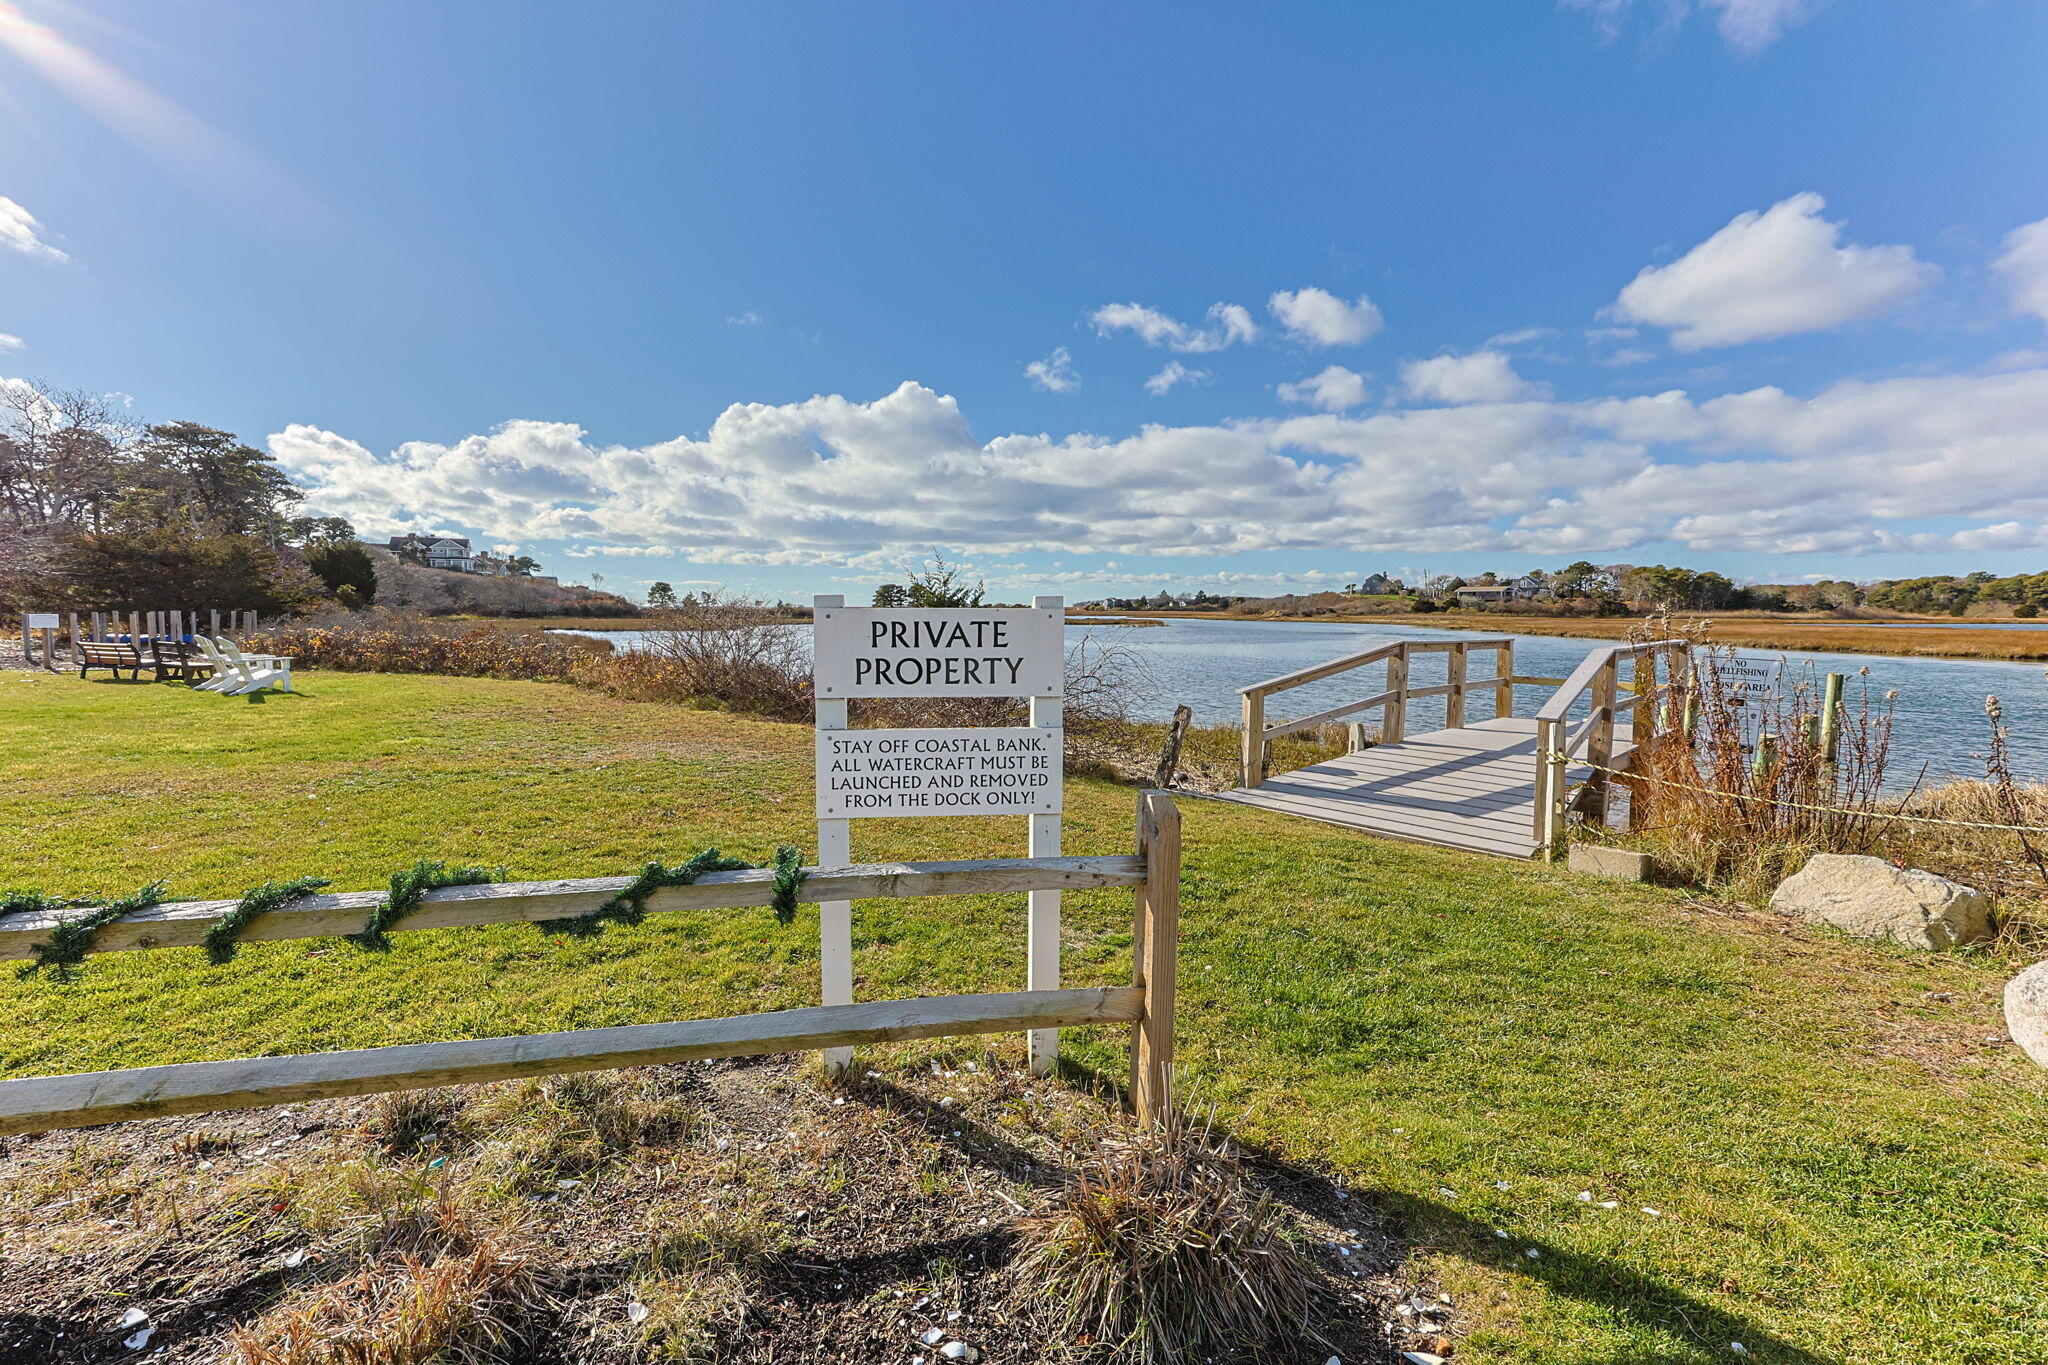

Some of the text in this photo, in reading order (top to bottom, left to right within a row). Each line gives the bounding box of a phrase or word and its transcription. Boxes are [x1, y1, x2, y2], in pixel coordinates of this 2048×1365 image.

[871, 621, 1008, 648] PRIVATE
[855, 658, 1024, 685] PROPERTY
[1712, 666, 1769, 677] HELLFISHING
[833, 738, 1046, 754] STAY OFF COASTAL BANK.
[831, 755, 1049, 772] ALL WATERCRAFT MUST BE
[832, 774, 1048, 790] LAUNCHED AND REMOVED
[845, 791, 1035, 808] FROM THE DOCK ONLY!
